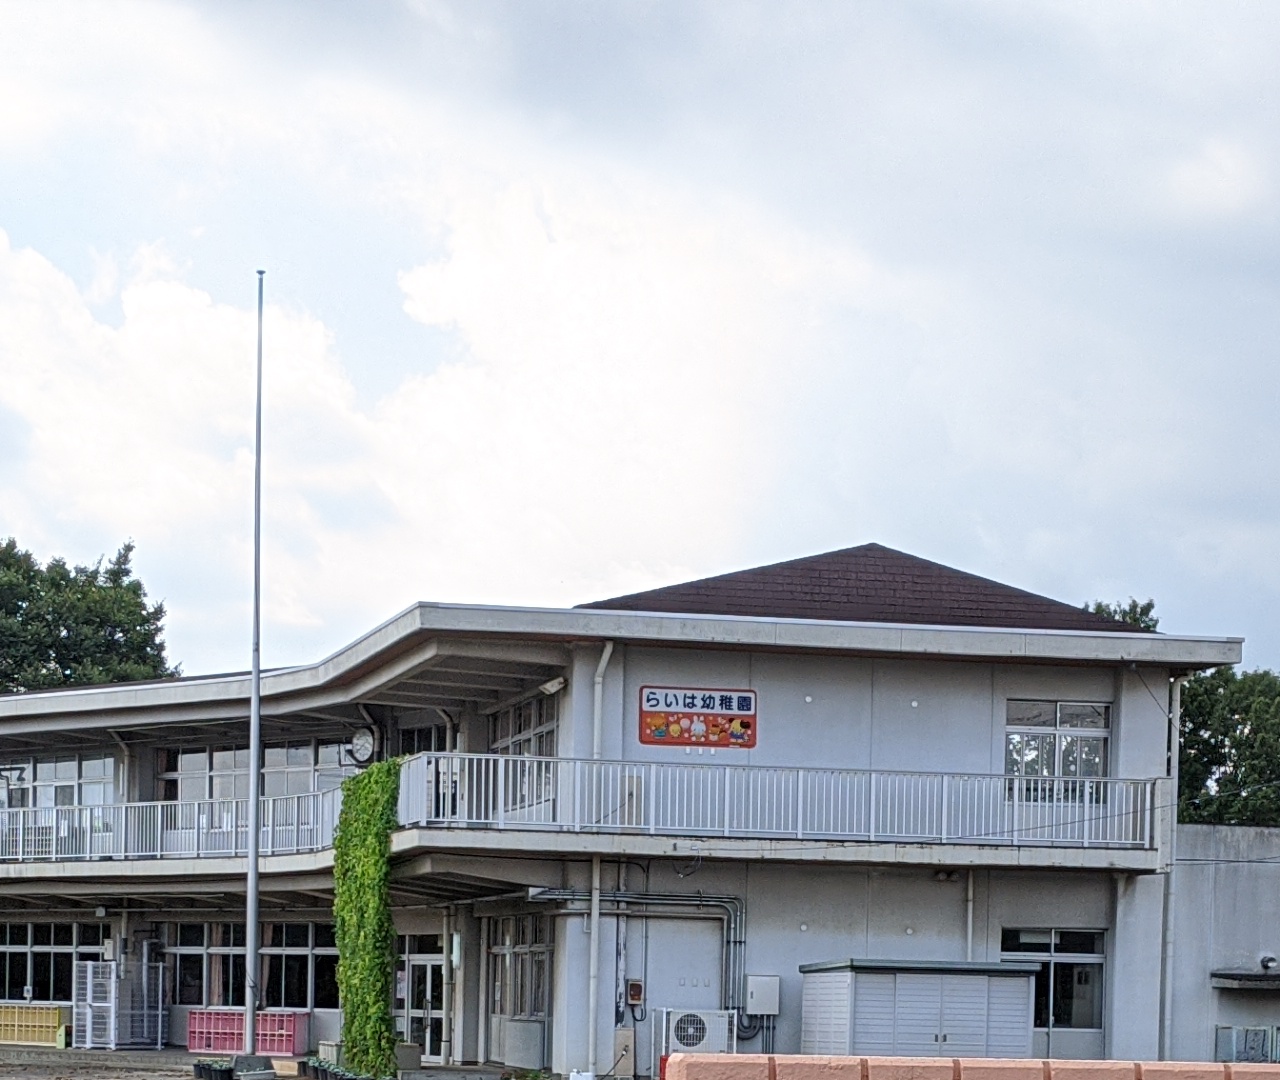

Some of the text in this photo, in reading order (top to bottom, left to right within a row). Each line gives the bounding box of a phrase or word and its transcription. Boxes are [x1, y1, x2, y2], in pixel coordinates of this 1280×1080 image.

[646, 692, 752, 711] らいは幼稚園
